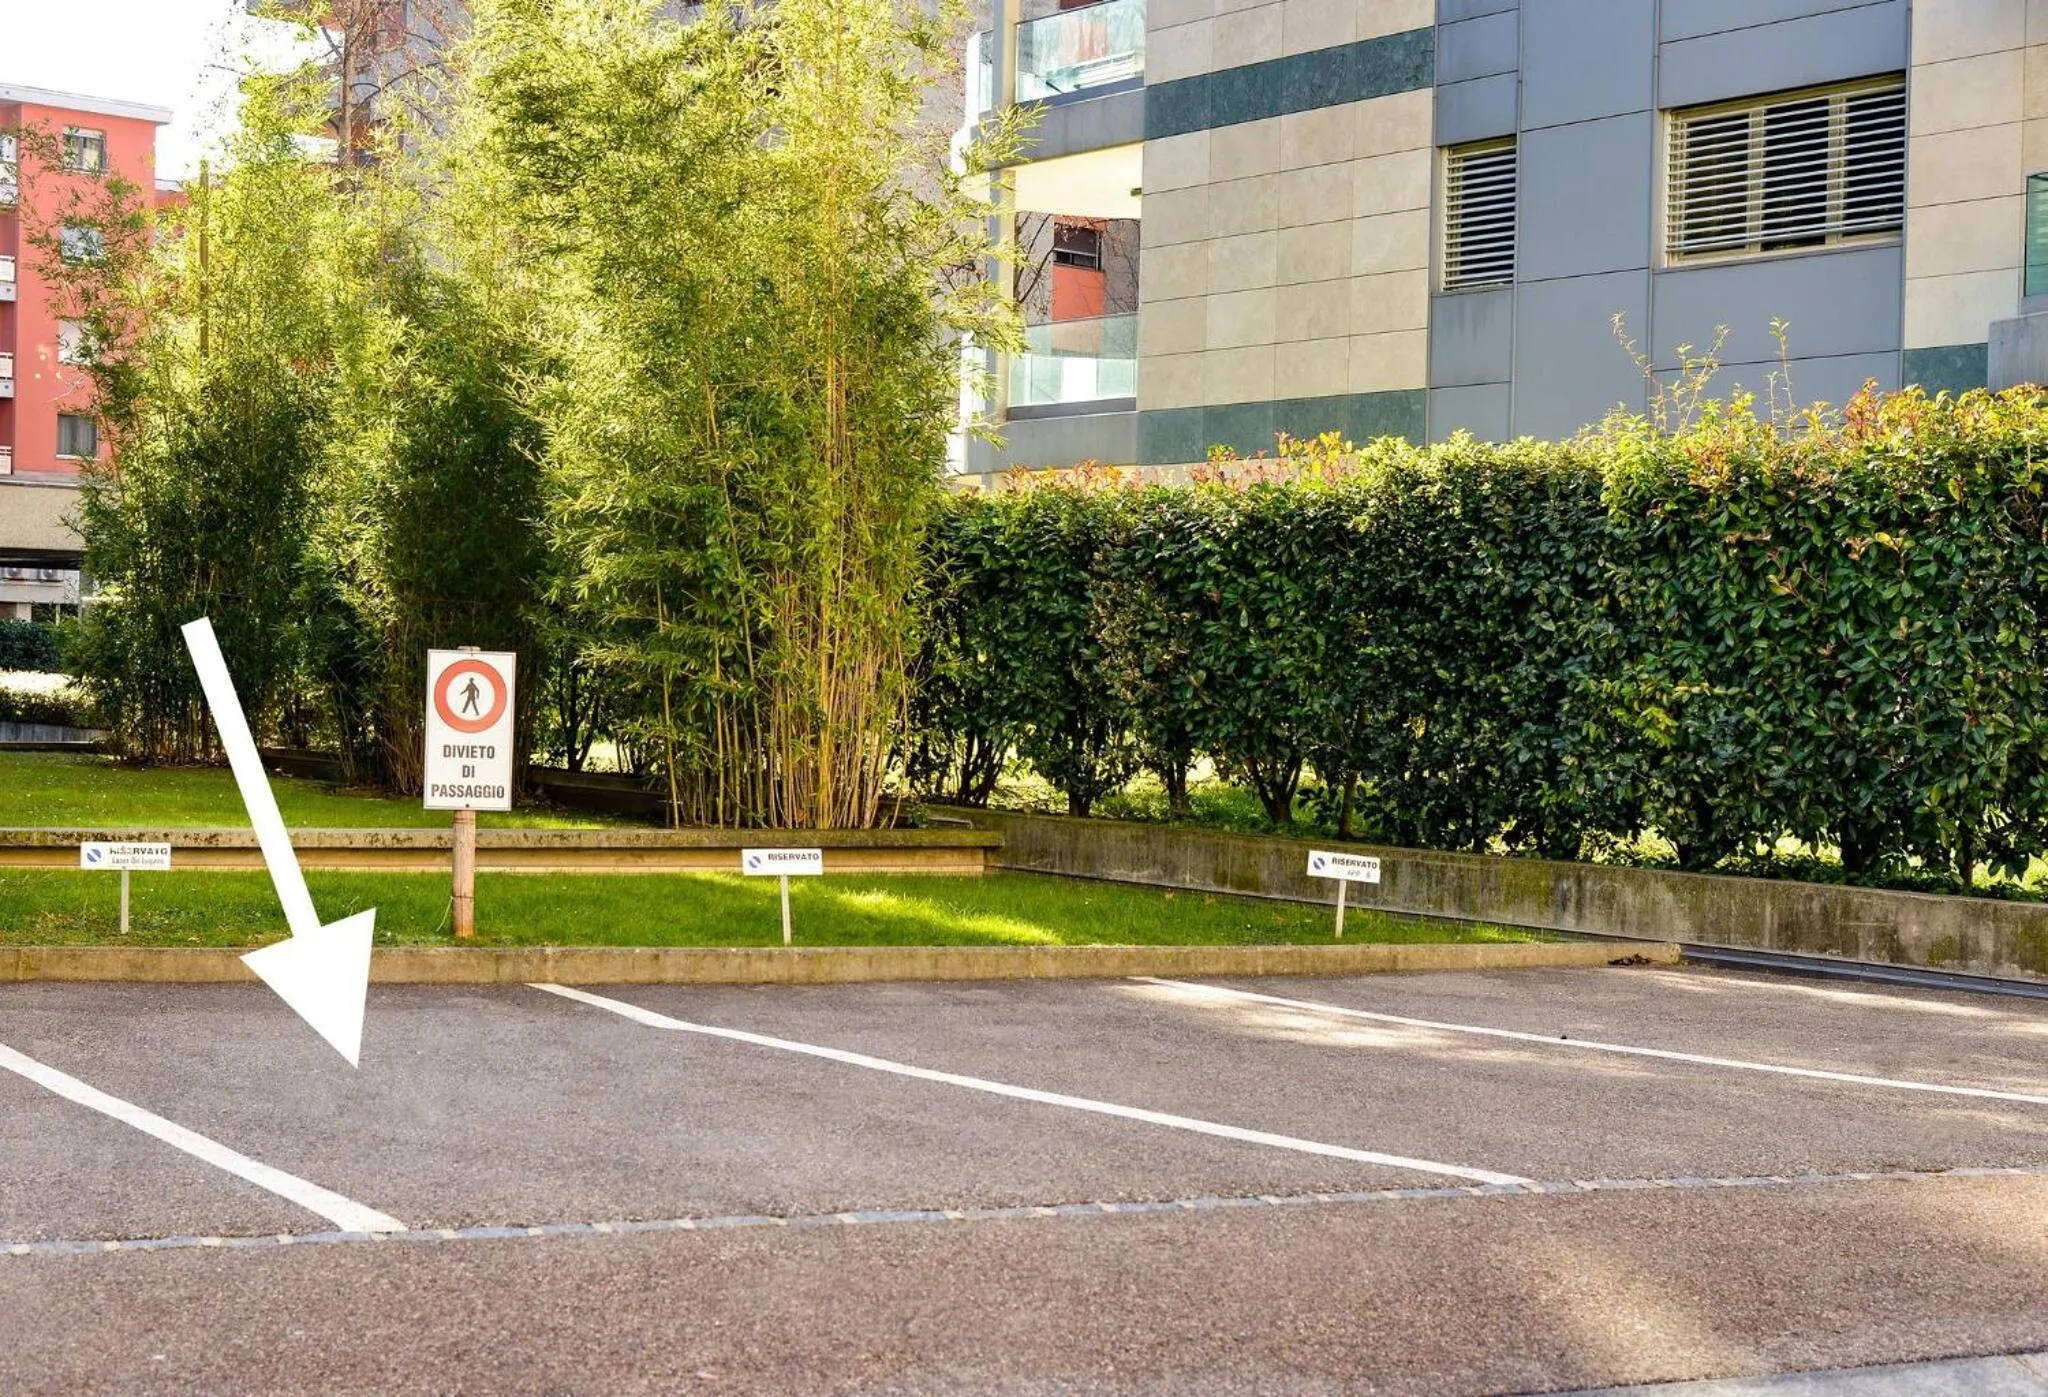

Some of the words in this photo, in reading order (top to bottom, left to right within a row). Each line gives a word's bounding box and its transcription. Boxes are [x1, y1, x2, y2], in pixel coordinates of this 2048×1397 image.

[443, 745, 495, 759] DIVIETO
[462, 765, 475, 778] DI
[431, 784, 505, 799] PASSAGGIO
[768, 853, 820, 861] RISERVATO
[1332, 857, 1378, 869] RISERVATO
